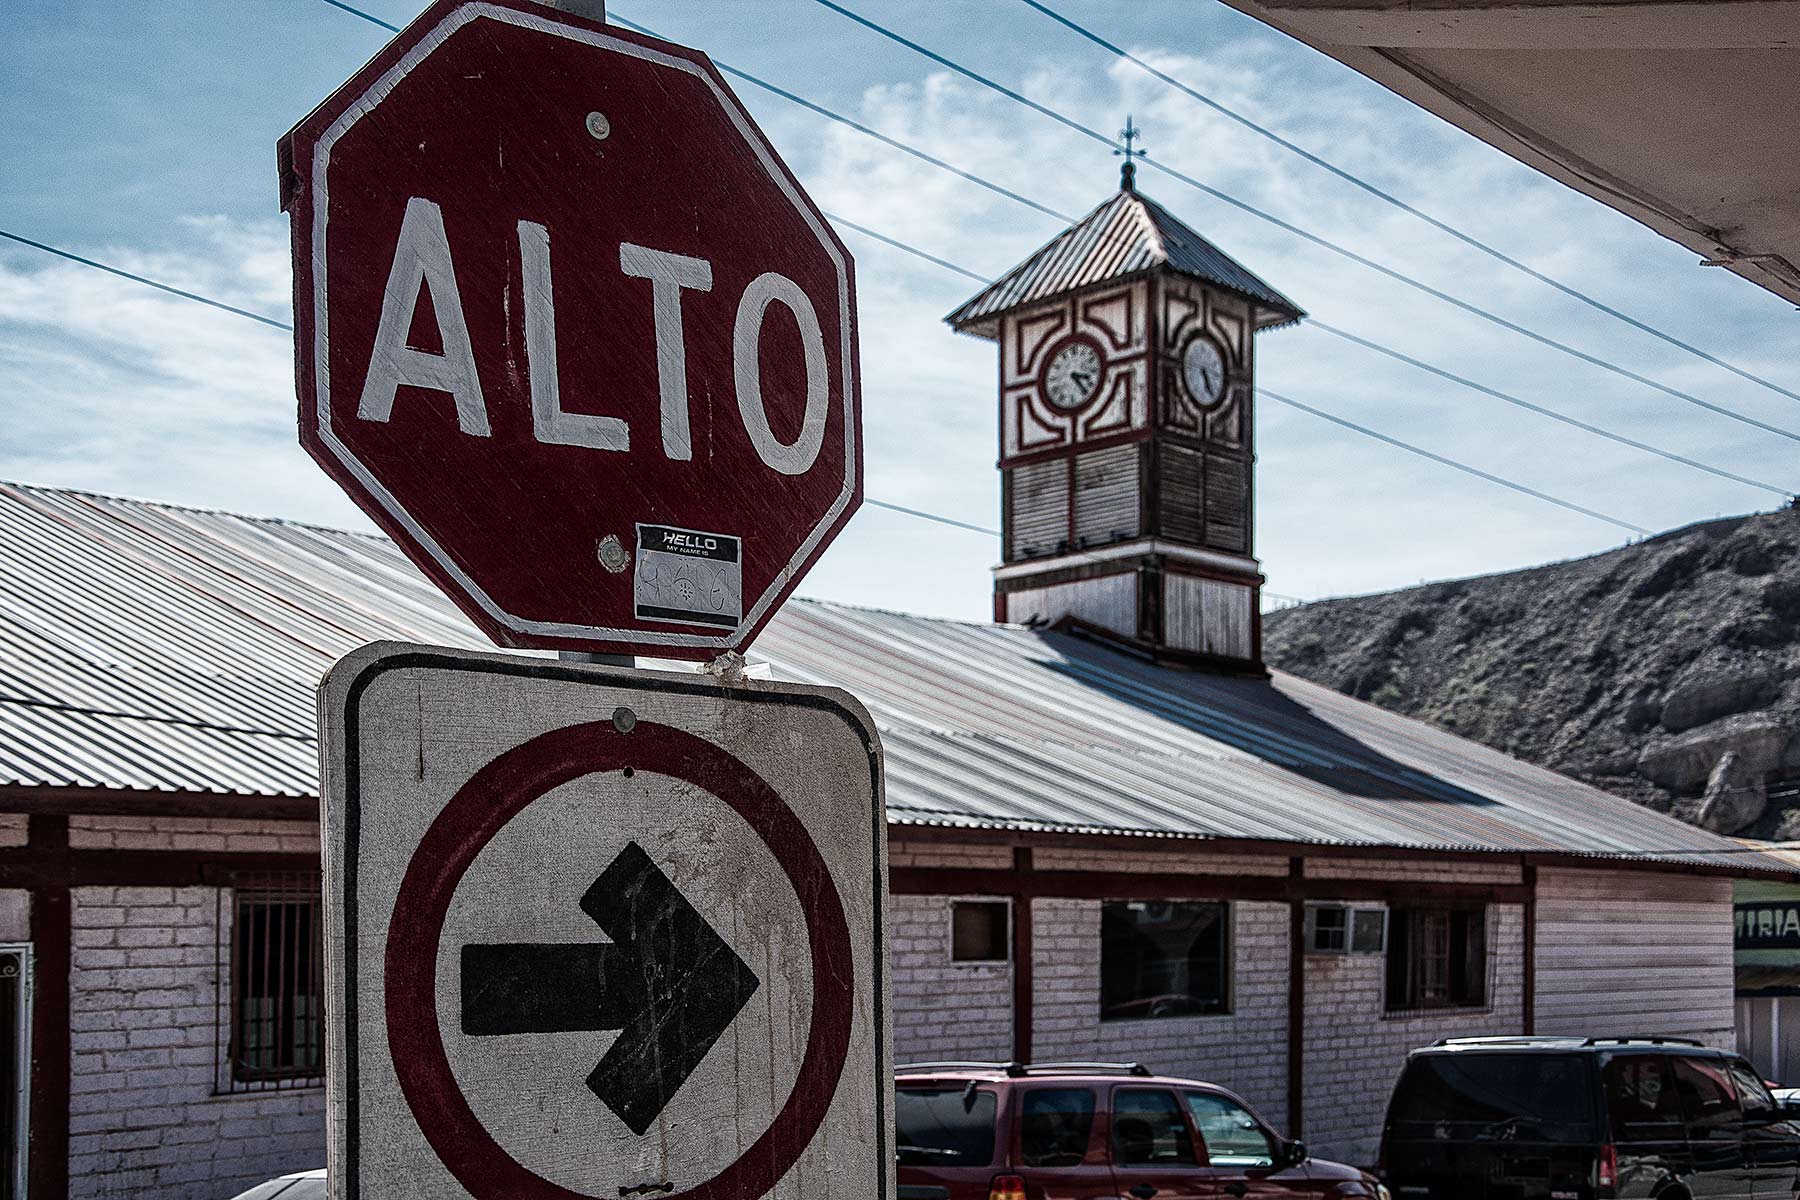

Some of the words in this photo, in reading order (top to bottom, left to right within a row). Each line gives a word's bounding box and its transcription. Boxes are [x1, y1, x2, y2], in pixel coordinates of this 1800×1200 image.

[357, 196, 829, 475] ALTO
[662, 531, 717, 550] HELLO
[679, 547, 701, 555] NAME
